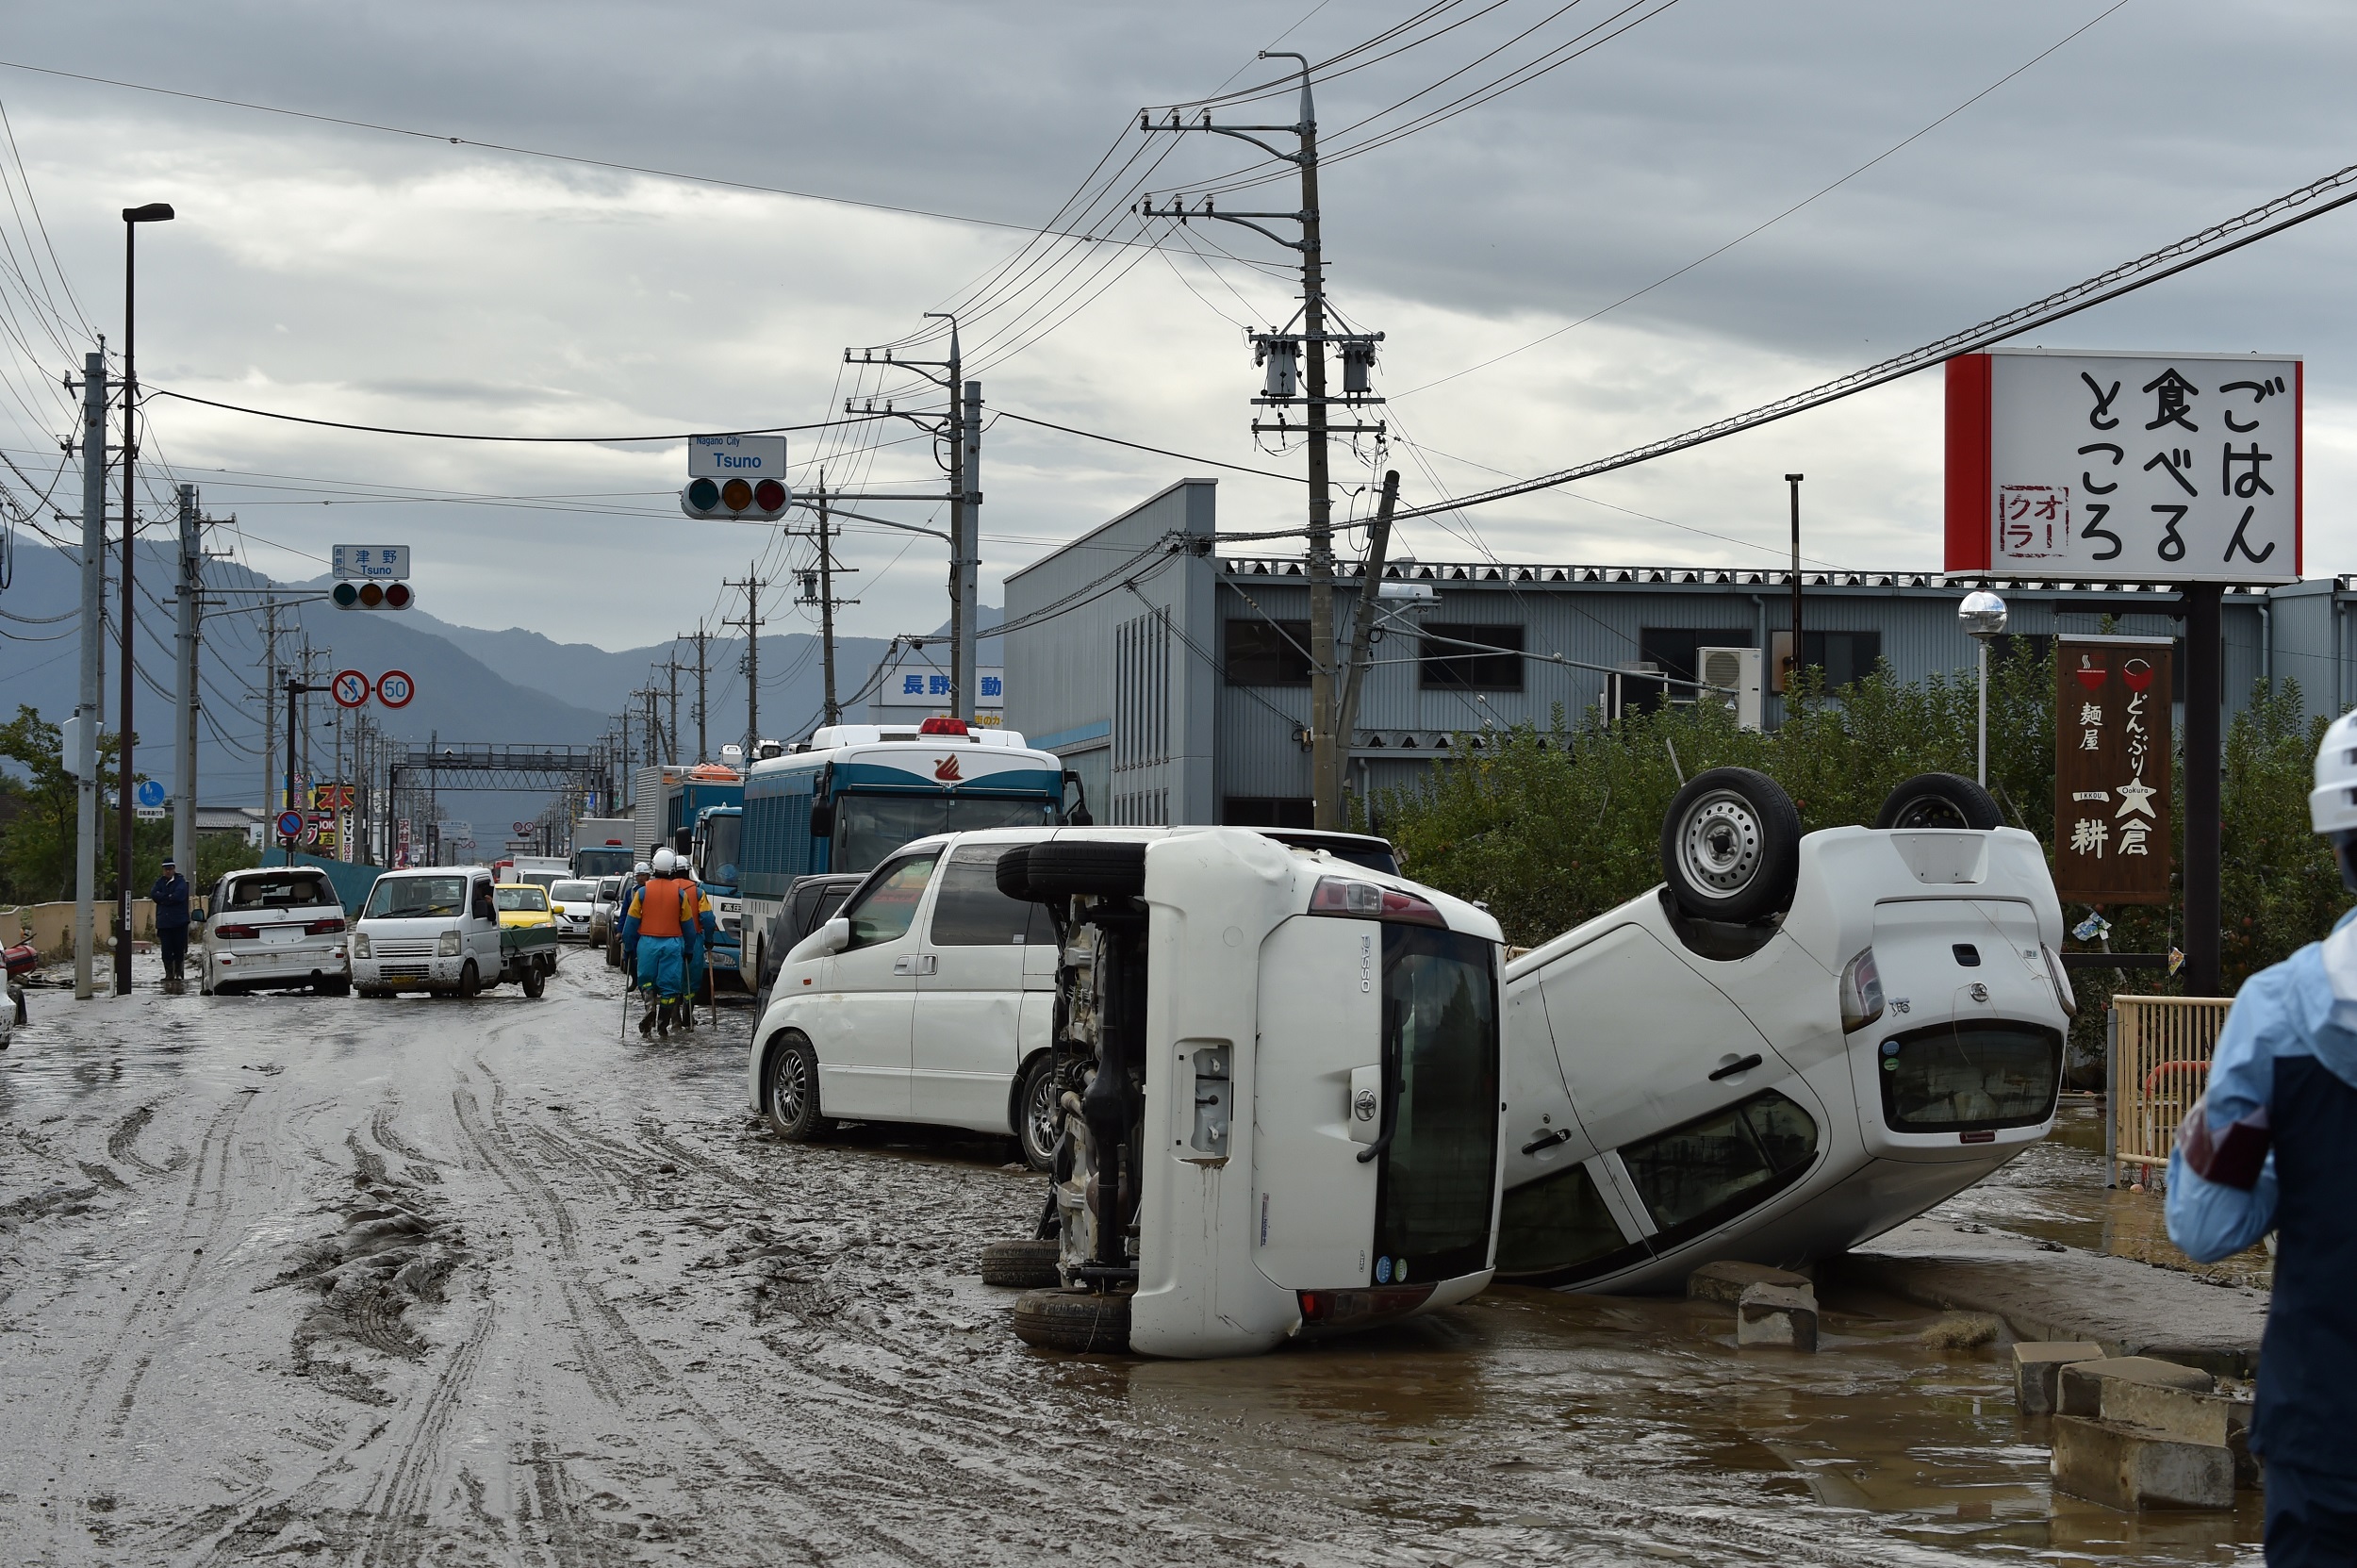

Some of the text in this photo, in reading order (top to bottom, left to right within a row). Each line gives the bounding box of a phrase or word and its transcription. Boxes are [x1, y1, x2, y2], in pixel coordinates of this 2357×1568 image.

[696, 436, 741, 448] Nagano City
[713, 453, 762, 469] Tsuno
[2077, 371, 2125, 561] ところ
[2142, 367, 2200, 562] 食べる
[2219, 375, 2285, 564] ごはん
[335, 548, 343, 575] 長野市
[360, 565, 392, 575] Tsuno
[385, 681, 405, 698] 50
[2078, 701, 2103, 751] 麺屋
[2126, 691, 2149, 777] どんぶり
[2121, 786, 2150, 795] Ookura
[1361, 933, 1371, 993] PASSO
